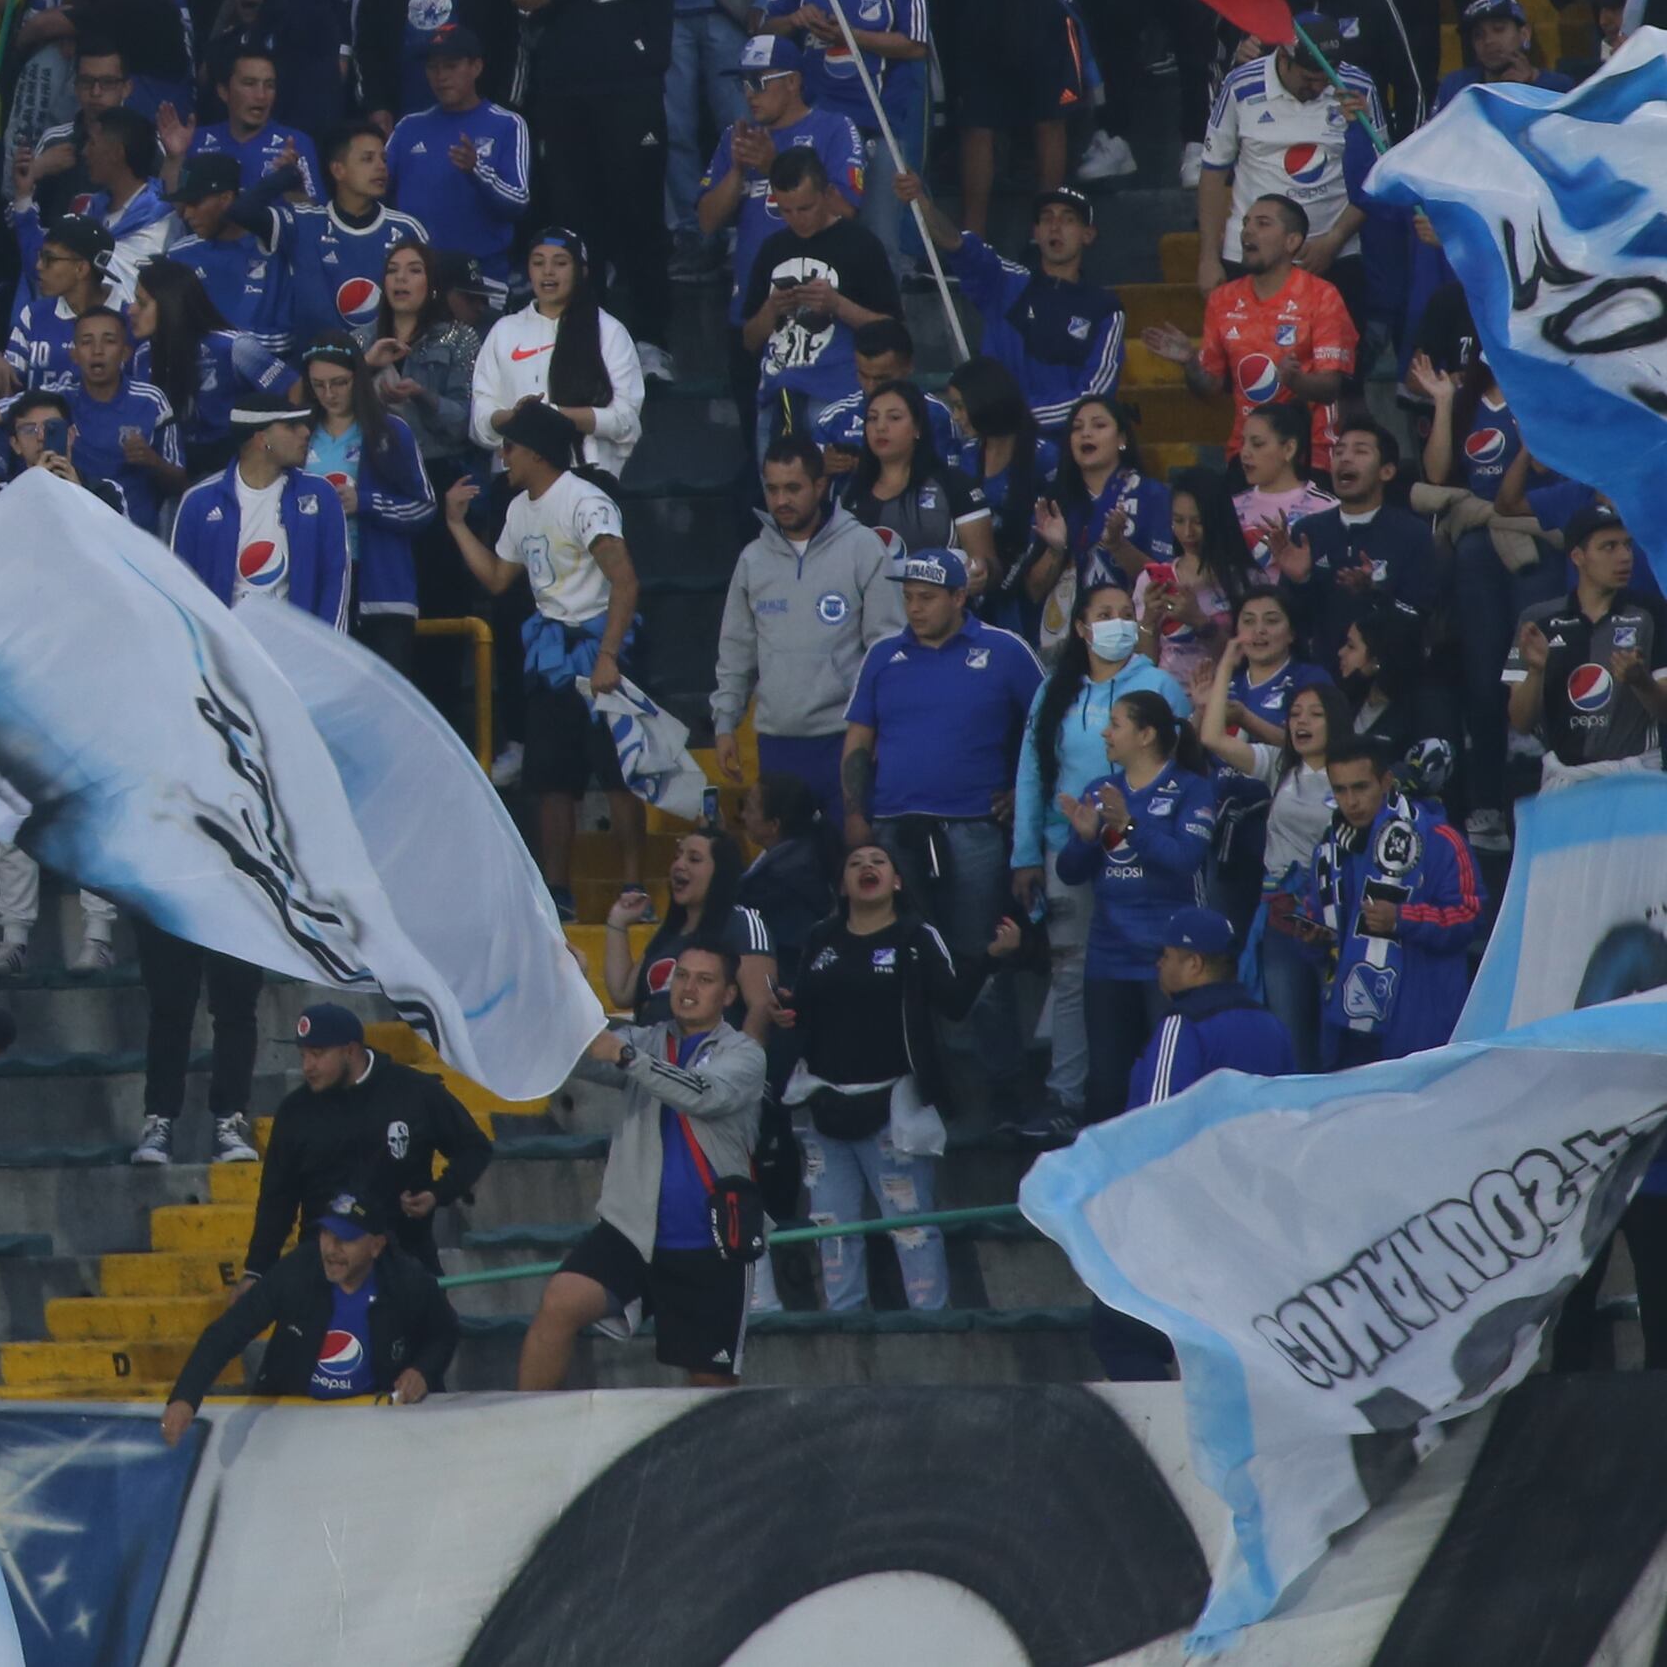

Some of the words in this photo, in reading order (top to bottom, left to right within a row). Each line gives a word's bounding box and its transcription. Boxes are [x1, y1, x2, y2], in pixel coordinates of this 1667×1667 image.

[1569, 715, 1610, 733] pepsi
[1105, 864, 1144, 884] pepsi
[218, 1261, 236, 1287] E
[1252, 1148, 1583, 1390] COMANDOS
[112, 1352, 132, 1377] D
[311, 1373, 354, 1392] pepsi
